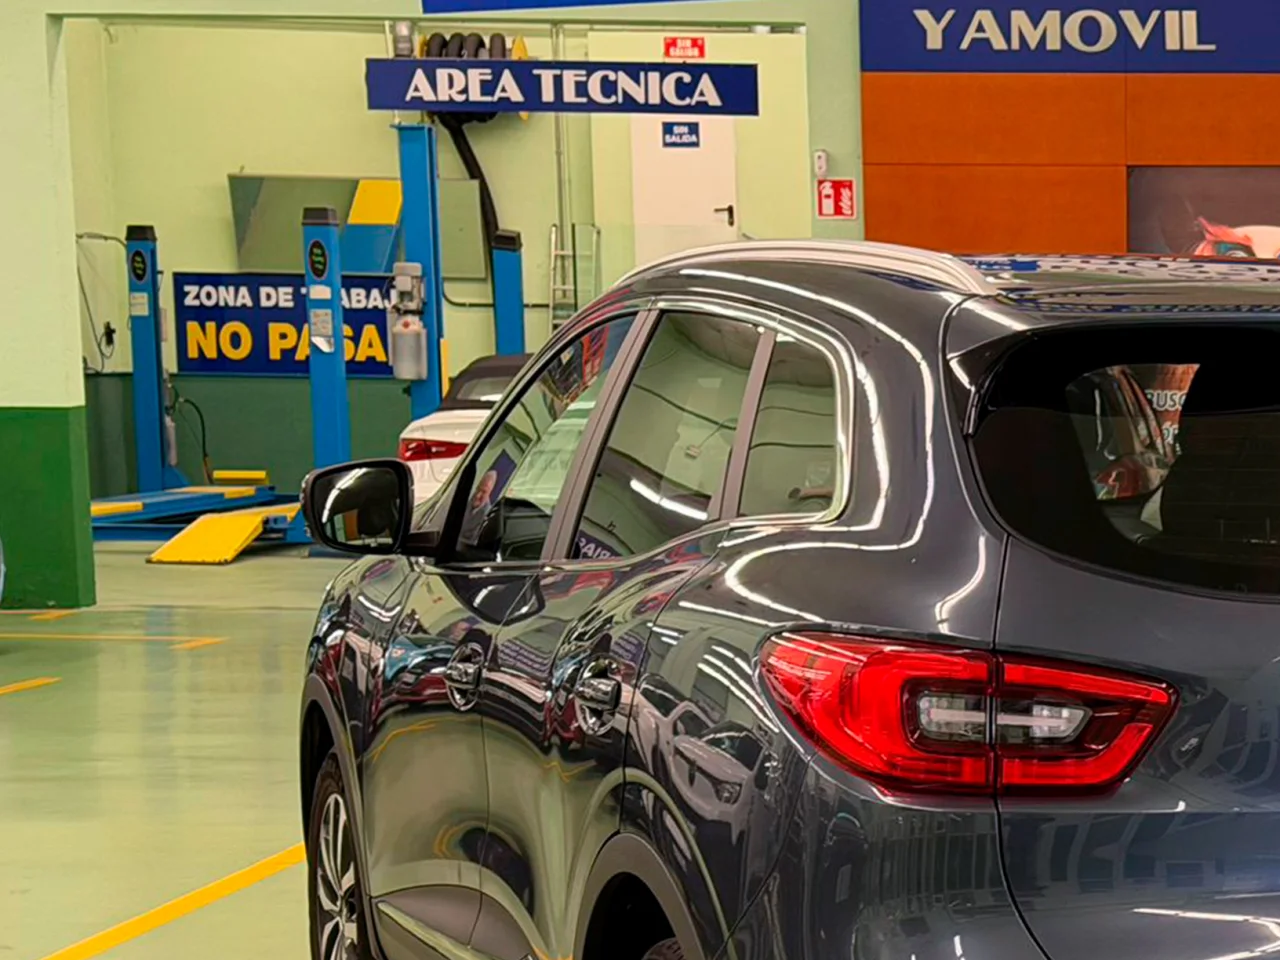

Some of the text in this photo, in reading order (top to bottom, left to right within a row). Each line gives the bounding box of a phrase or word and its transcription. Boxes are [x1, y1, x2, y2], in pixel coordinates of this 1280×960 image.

[913, 9, 1217, 53] YAMOVIL
[404, 67, 723, 107] AREA TECNICA
[183, 285, 253, 308] ZONA
[259, 286, 294, 308] DE
[186, 320, 254, 361] NO
